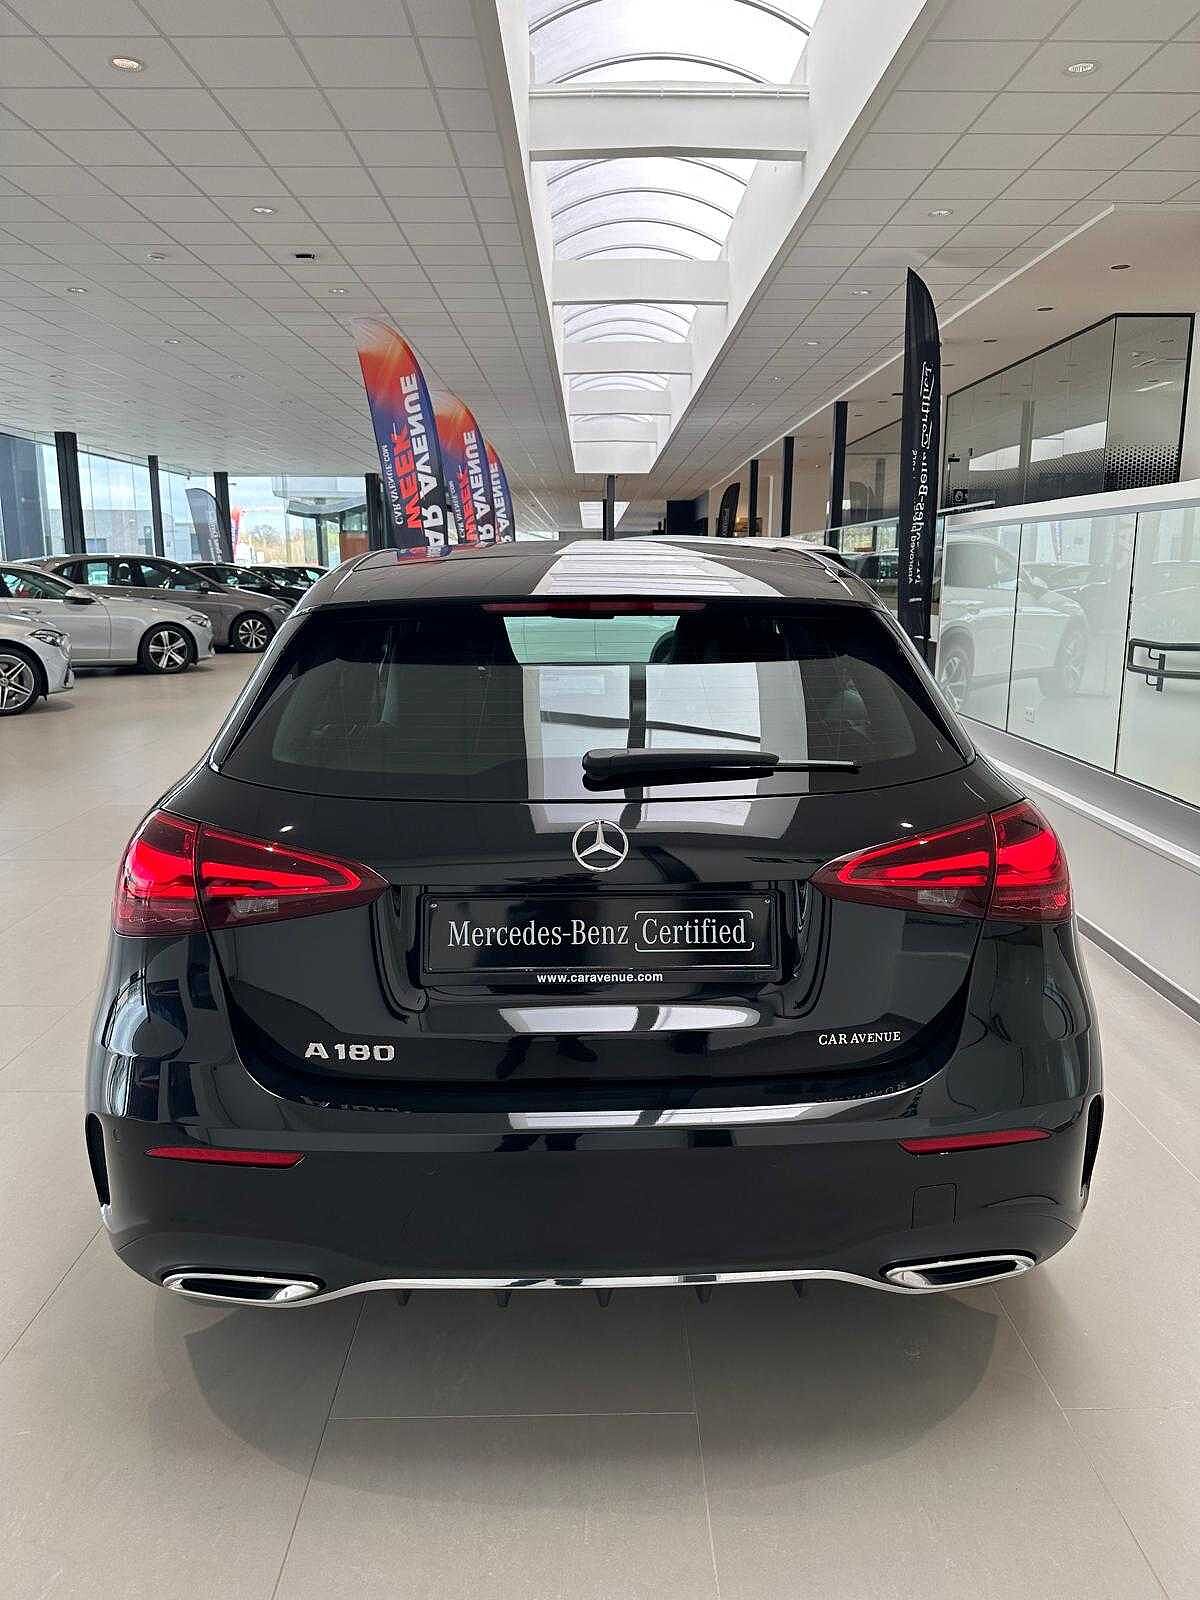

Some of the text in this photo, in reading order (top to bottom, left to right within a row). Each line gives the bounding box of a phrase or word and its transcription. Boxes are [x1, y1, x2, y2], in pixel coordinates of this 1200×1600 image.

[447, 917, 746, 947] Mercedes-Benz Certified
[536, 971, 663, 985] www.caravenue.com
[818, 1031, 901, 1046] CAR AVENUE
